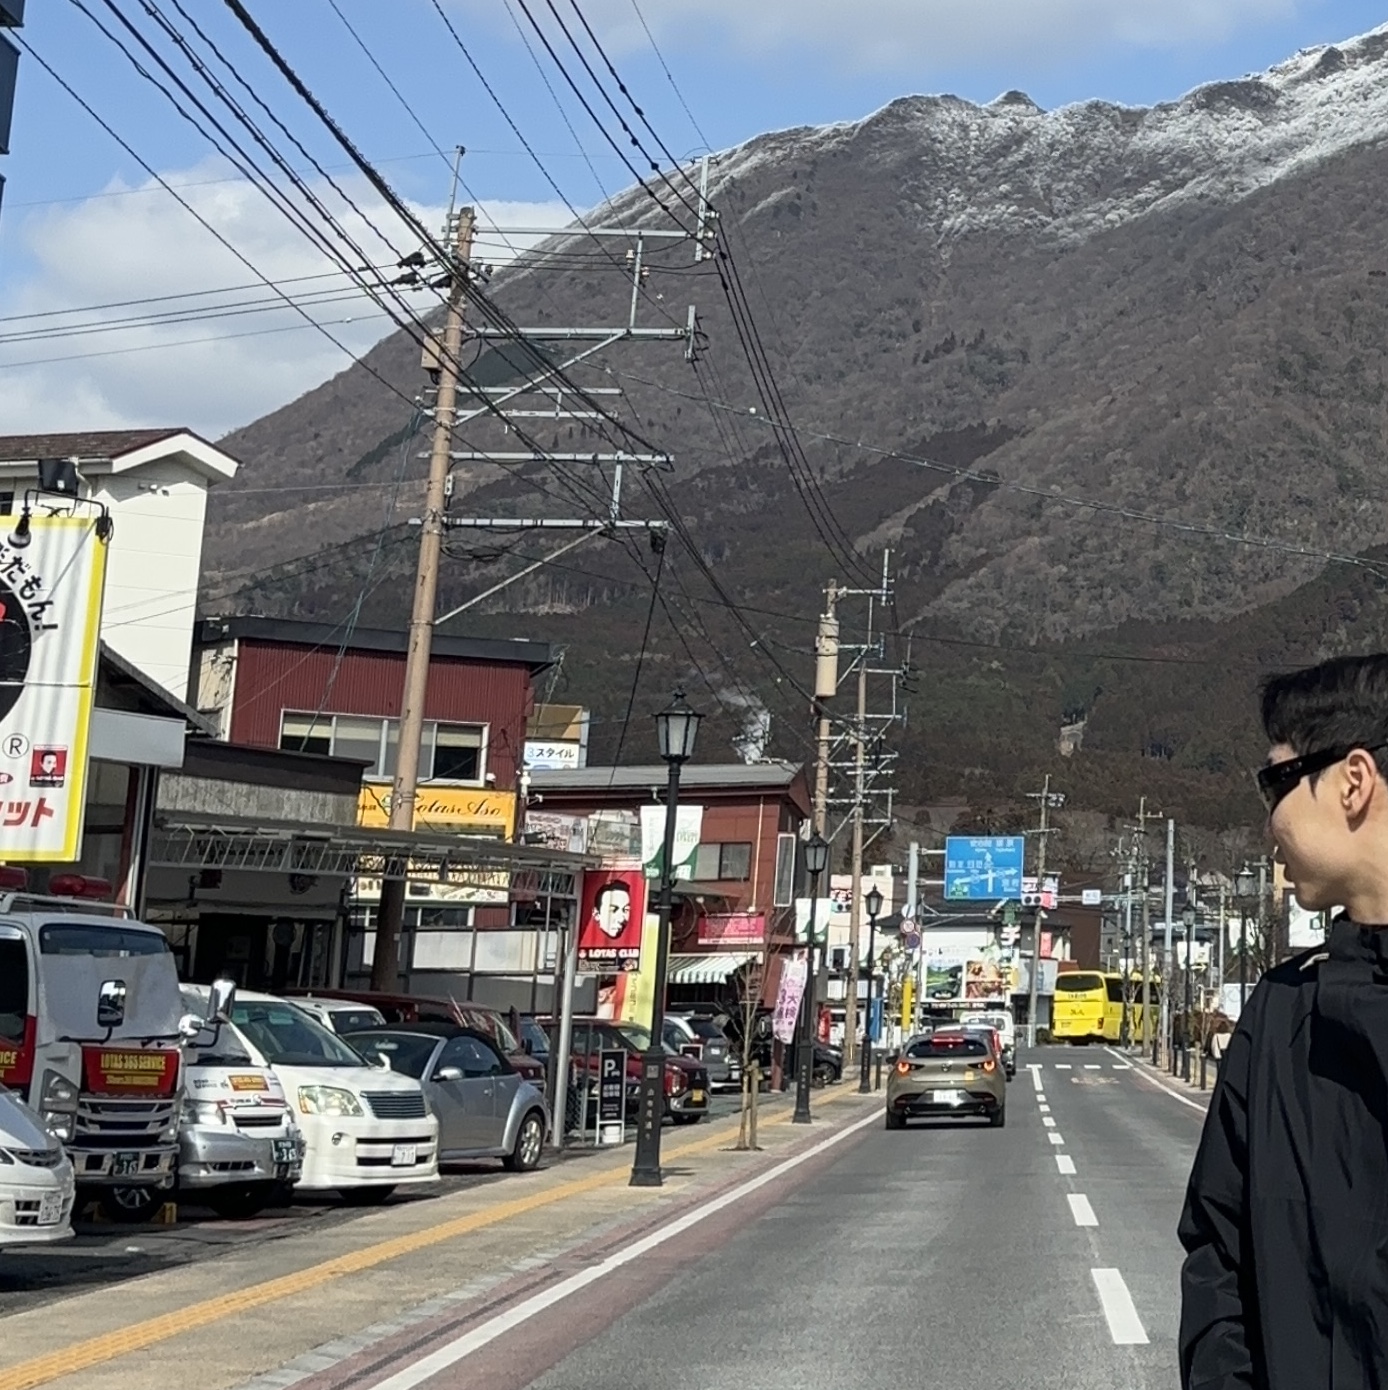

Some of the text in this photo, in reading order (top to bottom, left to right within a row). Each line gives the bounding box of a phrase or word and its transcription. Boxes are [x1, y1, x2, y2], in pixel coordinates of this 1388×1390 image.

[0, 797, 54, 827] ット
[588, 949, 639, 958] LOTAS CLUB
[603, 1059, 616, 1078] P
